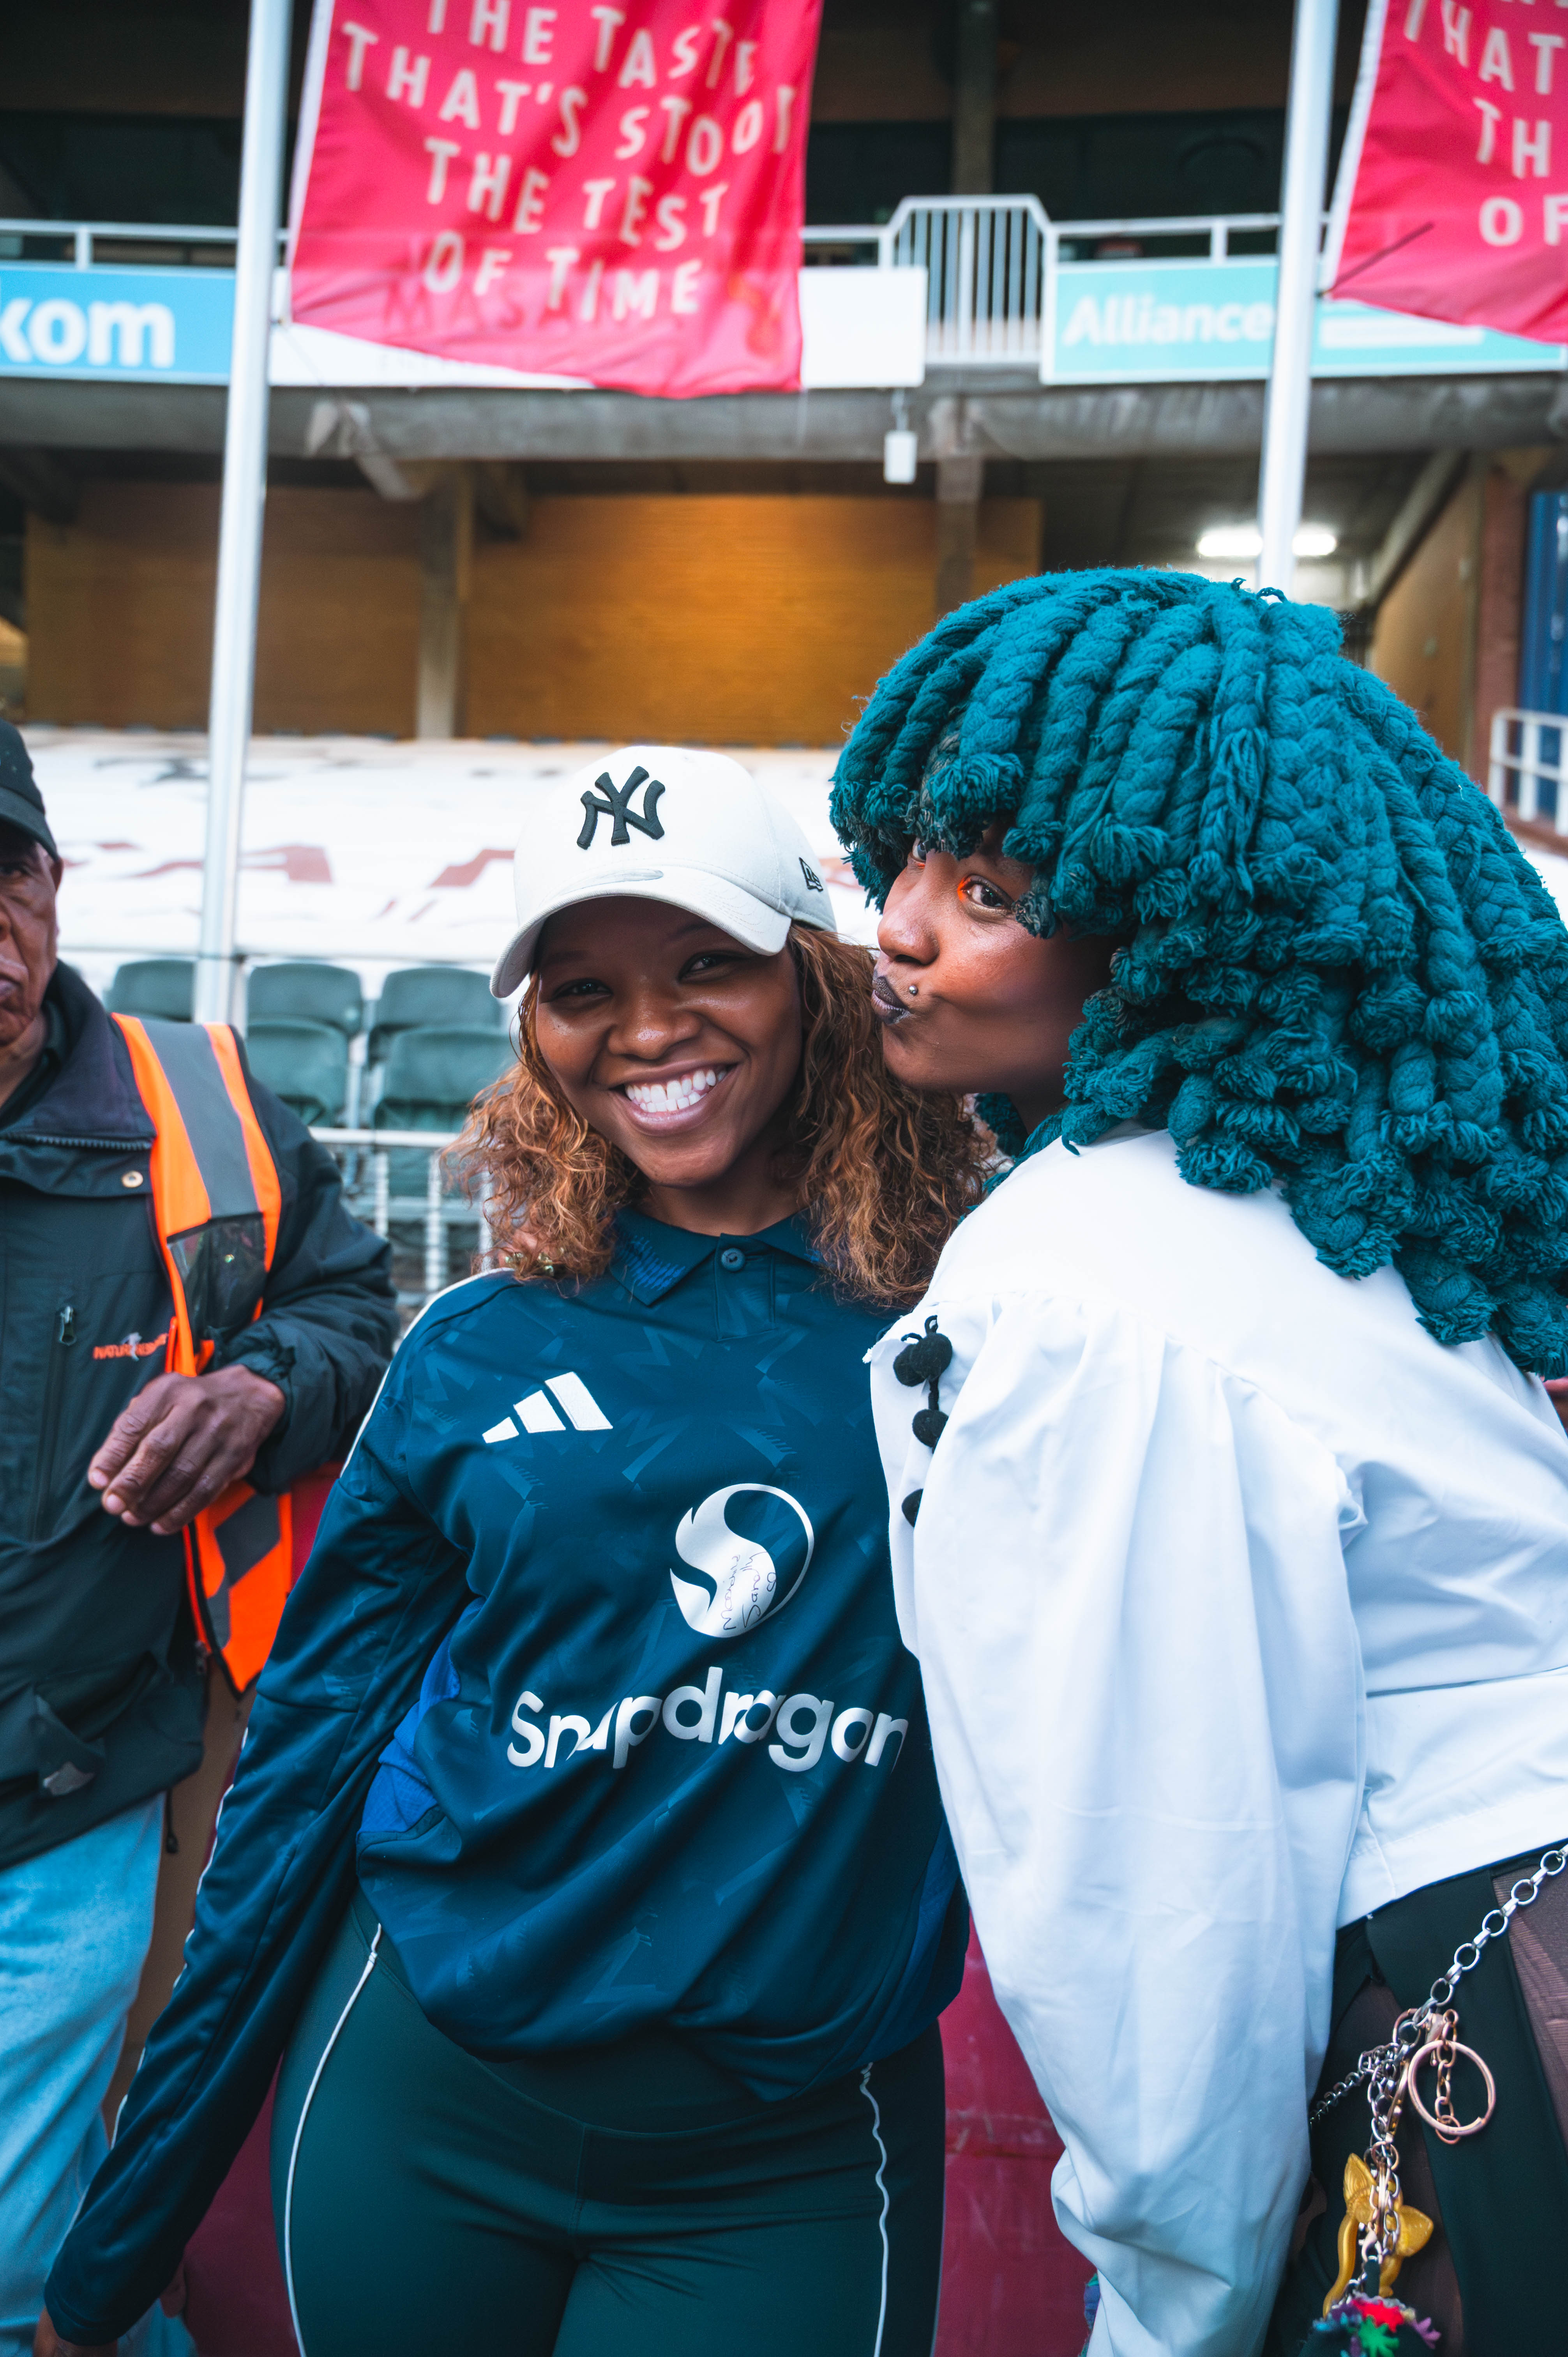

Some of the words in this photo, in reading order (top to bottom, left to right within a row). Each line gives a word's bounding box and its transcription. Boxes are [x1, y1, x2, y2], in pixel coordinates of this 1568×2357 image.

[342, 21, 588, 157] THAT'S
[590, 6, 758, 97] TASTE
[424, 137, 549, 234] THE
[583, 175, 729, 251] TEST
[1479, 196, 1568, 247] OF
[424, 231, 512, 295] OF
[546, 249, 703, 321] TIME
[1061, 292, 1275, 348] Alliance
[576, 765, 666, 850] NY
